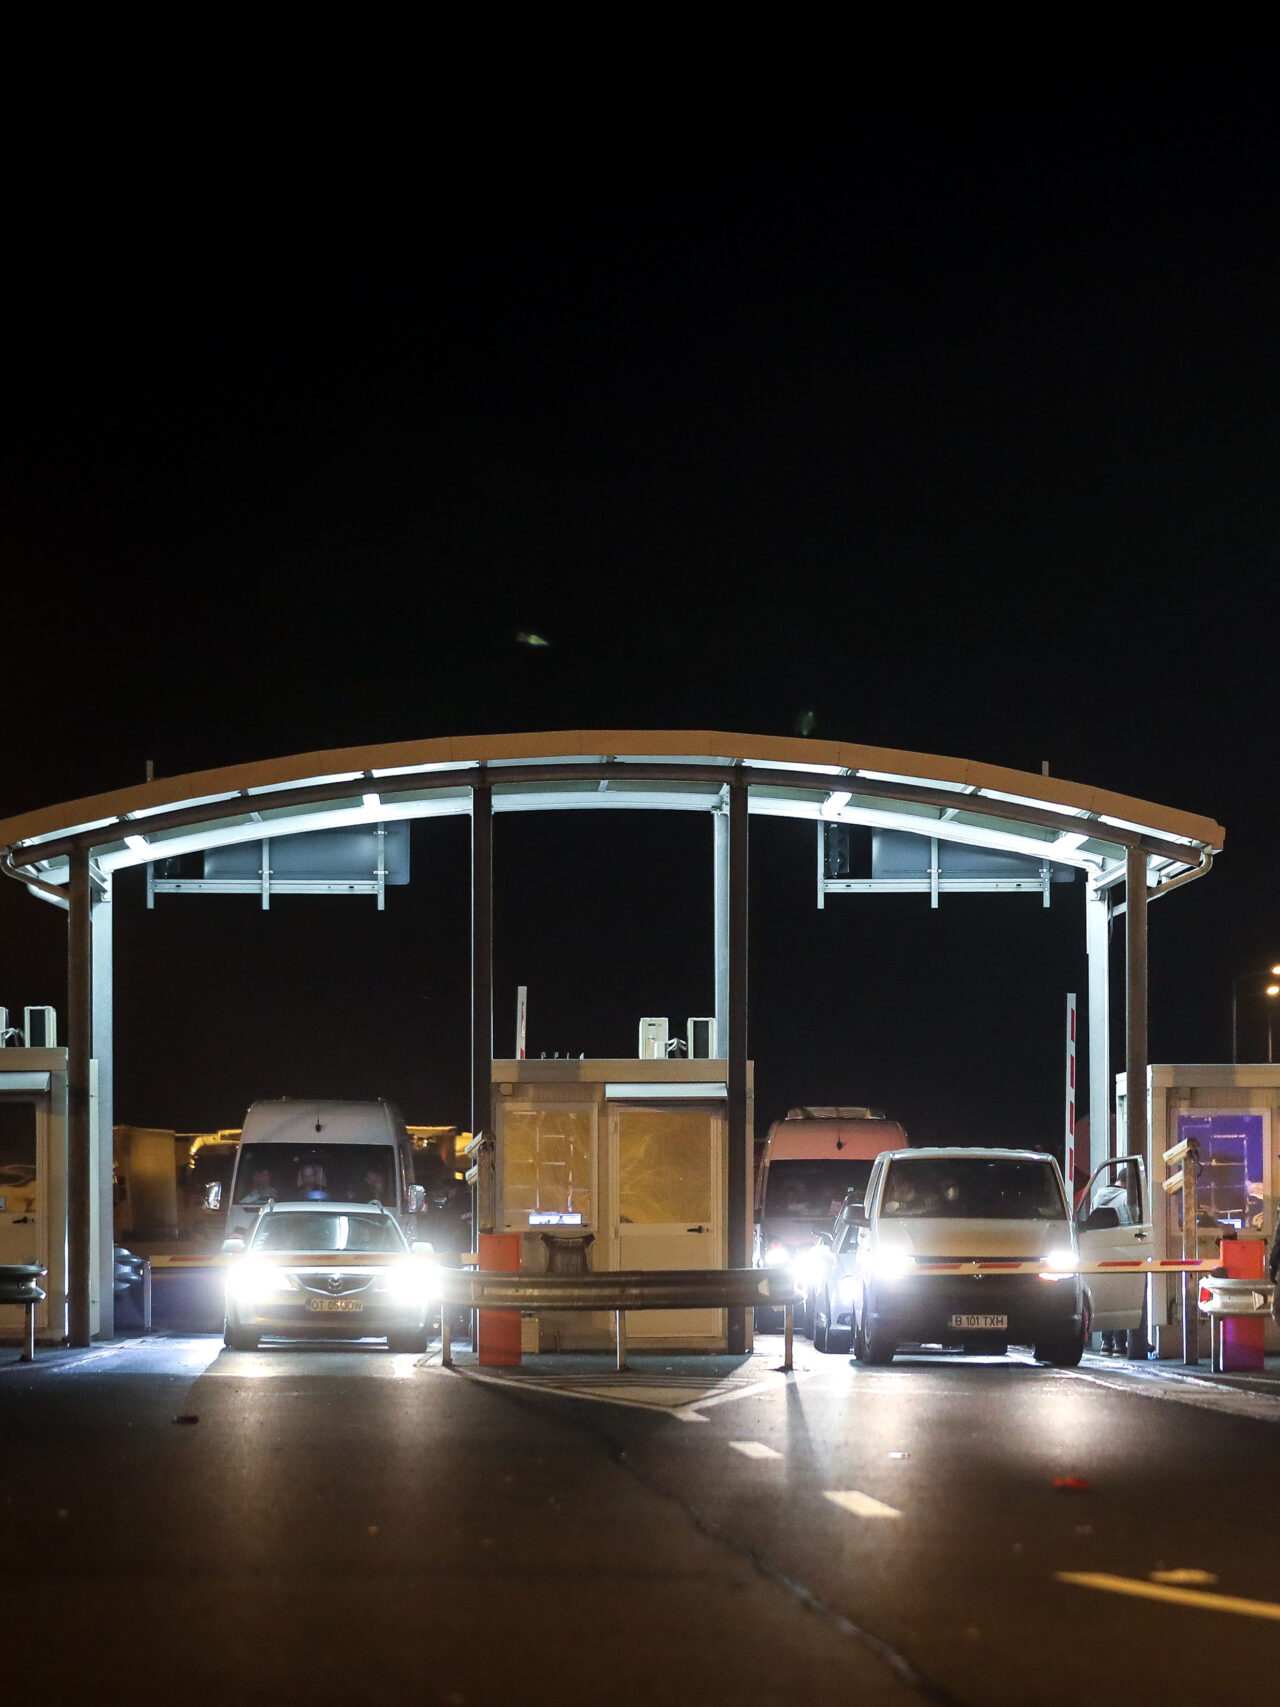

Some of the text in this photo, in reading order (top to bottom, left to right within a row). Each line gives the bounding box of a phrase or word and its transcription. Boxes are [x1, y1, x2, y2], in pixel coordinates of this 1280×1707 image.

[955, 1315, 1004, 1327] B 101 TXH
